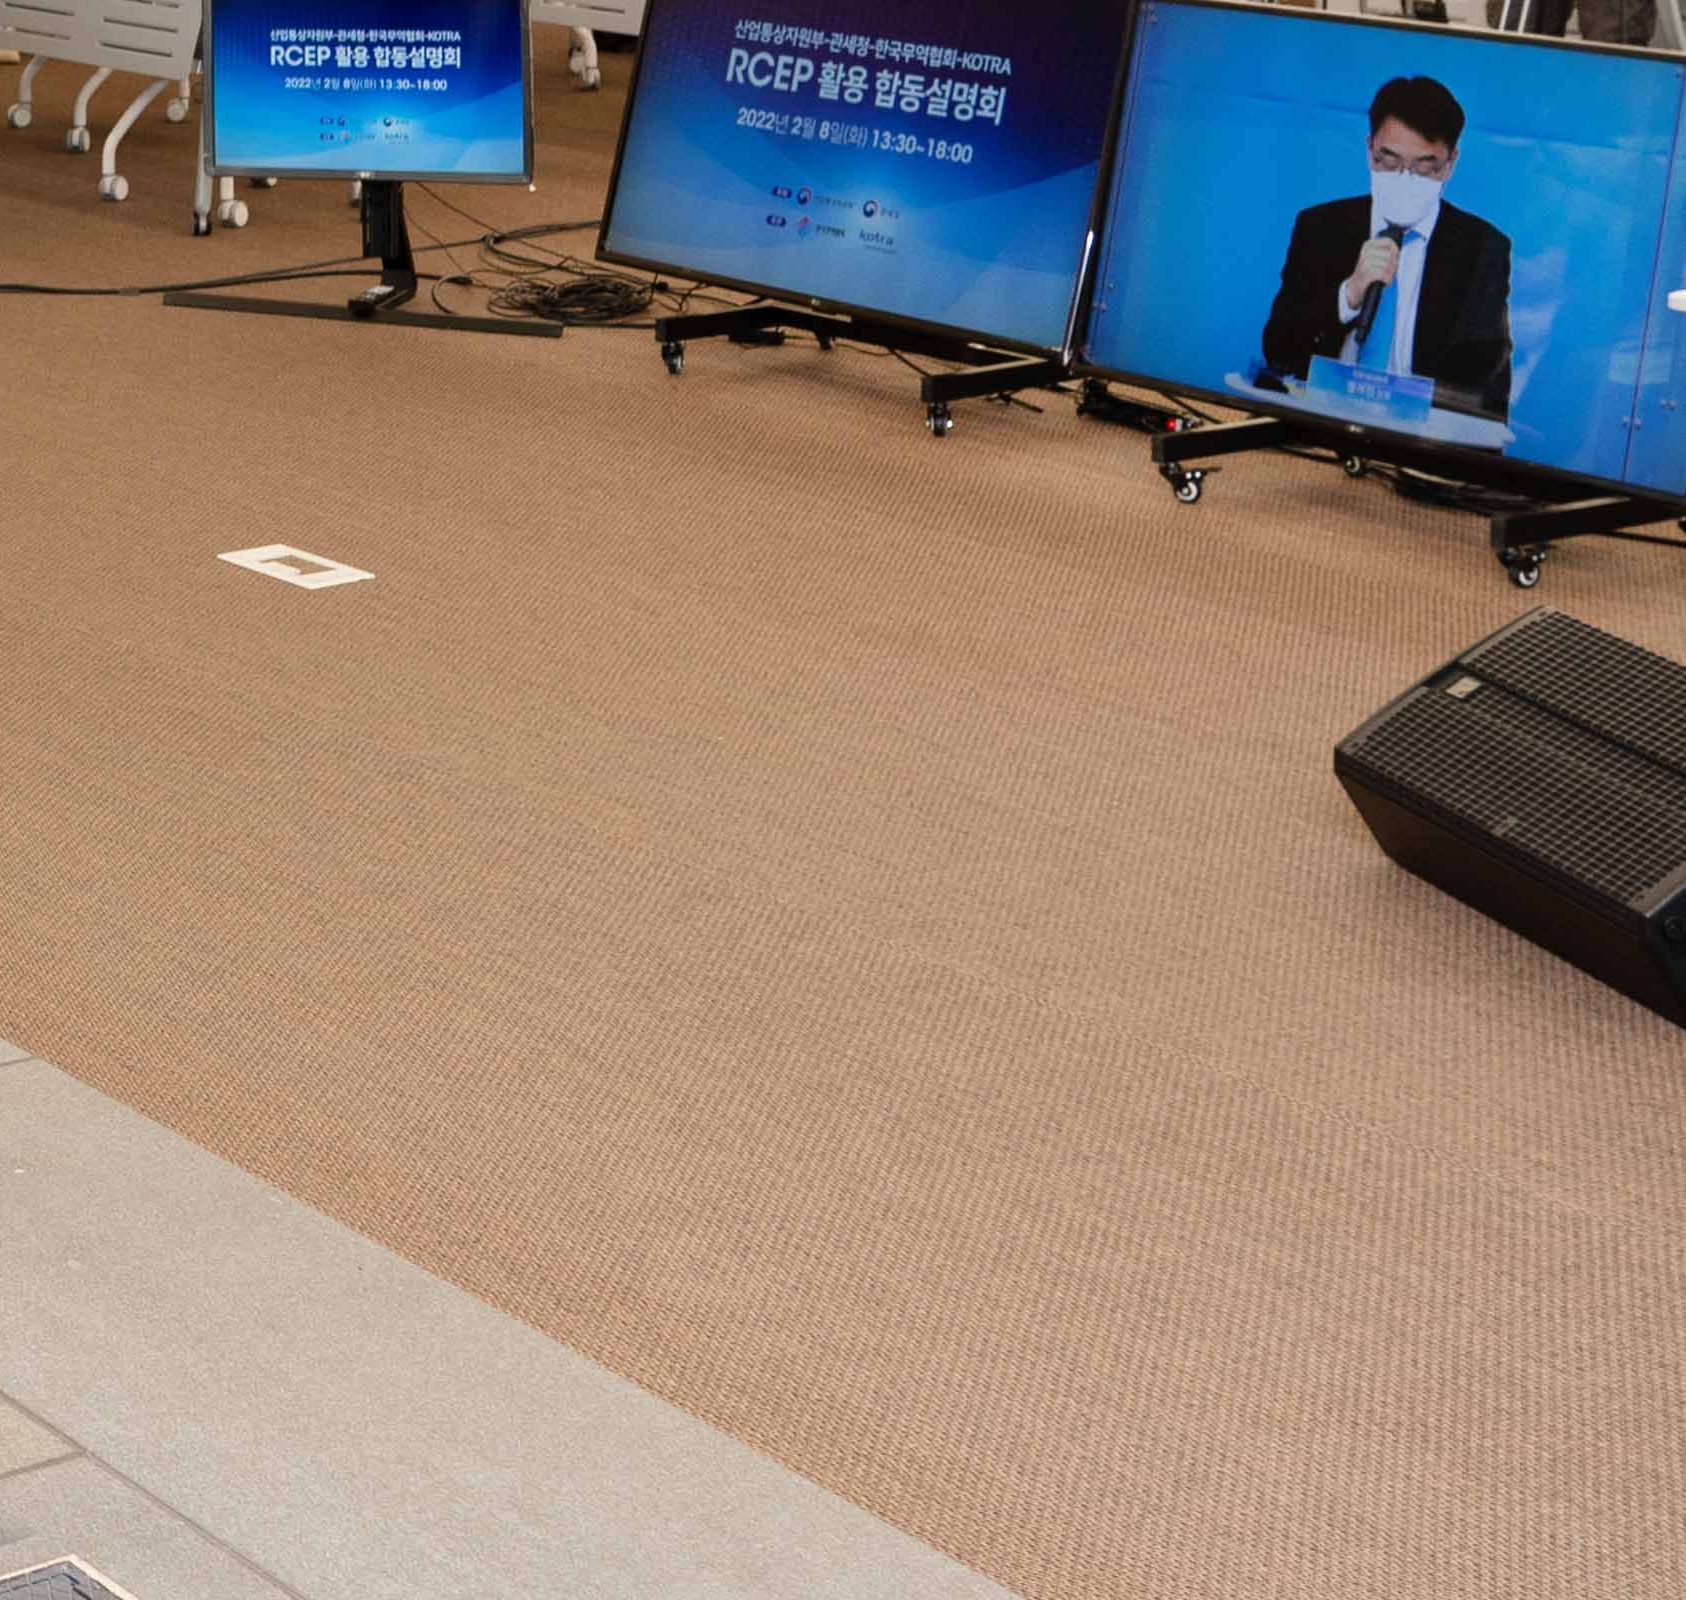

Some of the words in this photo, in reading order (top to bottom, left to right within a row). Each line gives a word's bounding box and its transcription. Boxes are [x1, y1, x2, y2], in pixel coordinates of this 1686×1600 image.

[270, 46, 330, 67] RCEP
[335, 46, 370, 68] 활용
[373, 46, 461, 69] 합동설명회
[726, 48, 814, 92] RCEP
[818, 61, 868, 104] 활용
[875, 70, 1006, 126] 합동설명회
[736, 107, 789, 135] 2022년
[791, 116, 816, 139] 2월
[819, 122, 868, 147] 8일(화)
